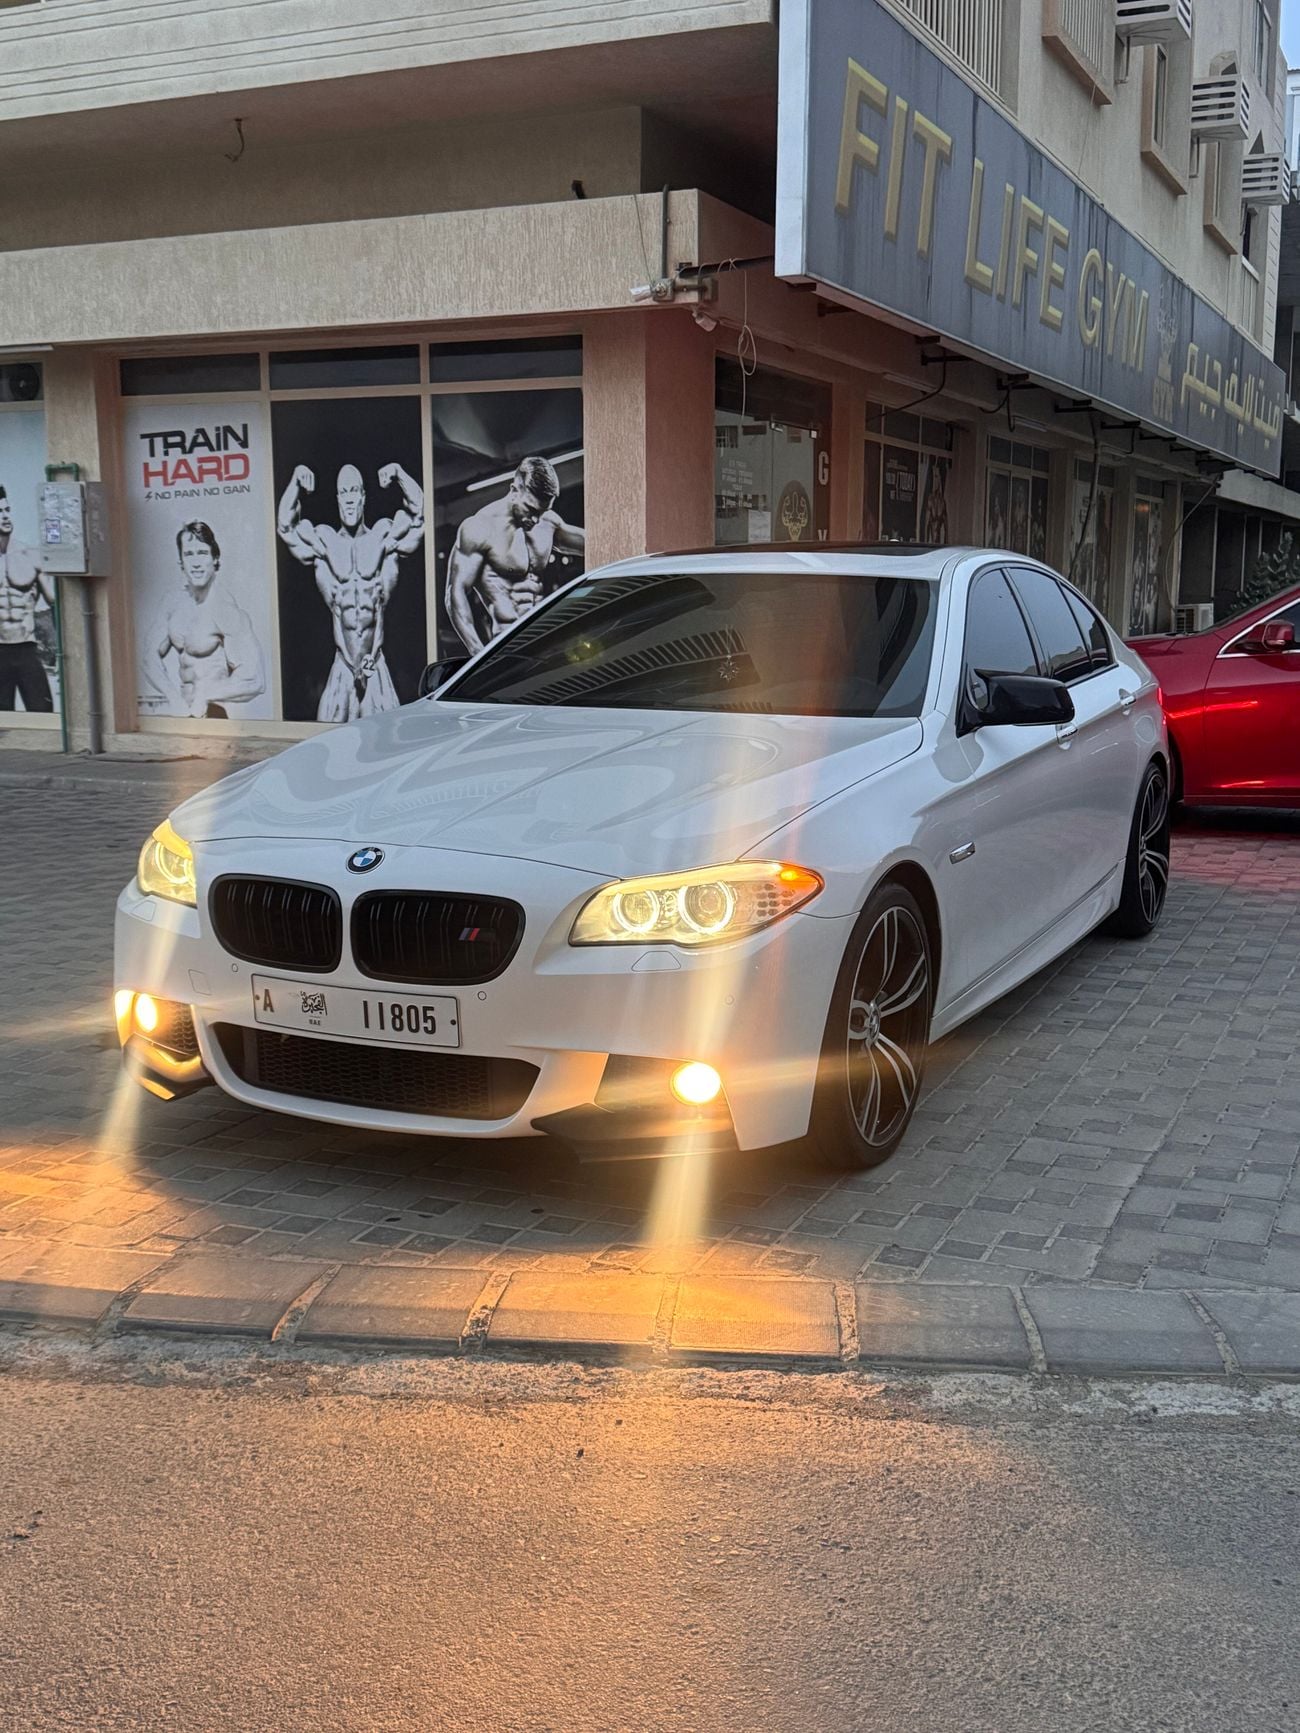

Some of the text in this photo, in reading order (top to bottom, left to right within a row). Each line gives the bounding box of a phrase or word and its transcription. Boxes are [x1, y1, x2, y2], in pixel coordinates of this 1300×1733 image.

[835, 57, 1149, 373] FIT LIFE GYM
[1180, 342, 1222, 420] جيم
[140, 423, 249, 458] TRAIN
[143, 453, 250, 488] HARD
[155, 484, 251, 500] NO PAIN NO GAIN
[362, 658, 375, 671] 22
[263, 988, 436, 1035] A 11805
